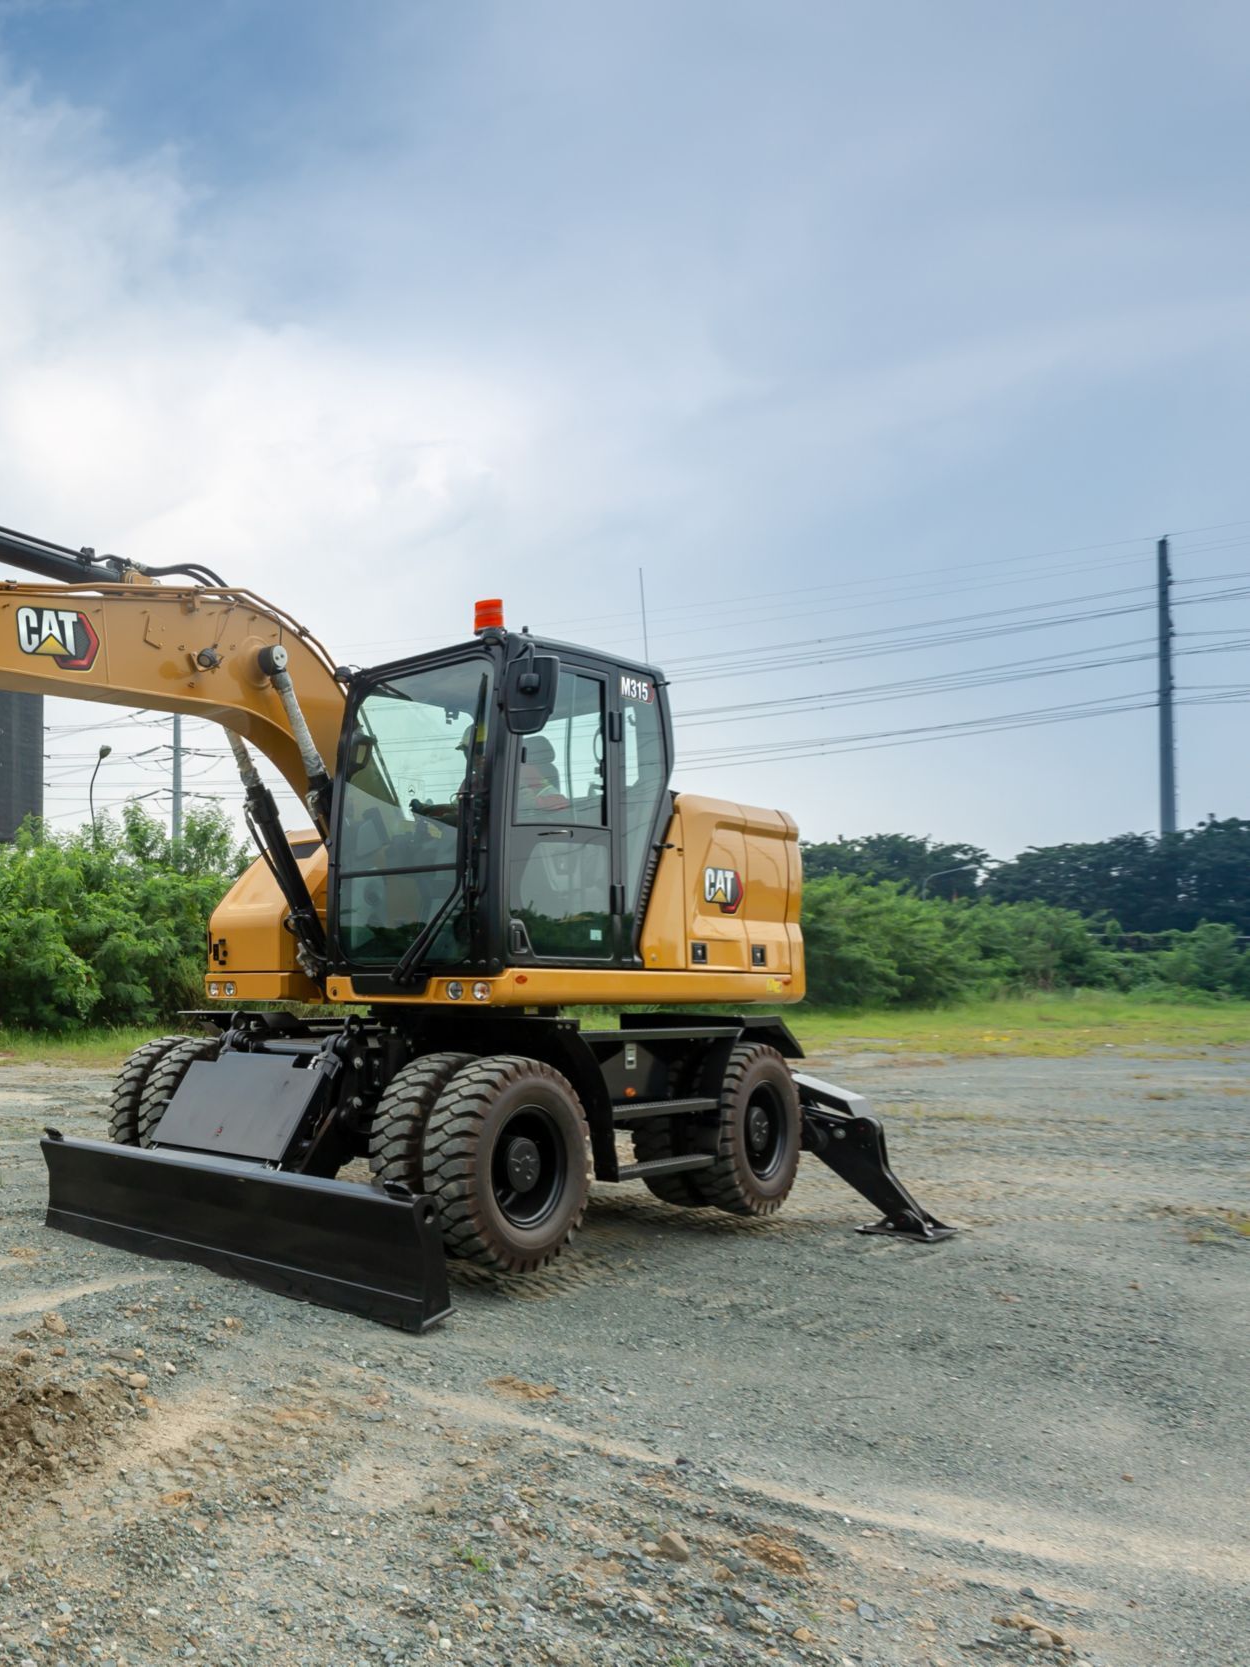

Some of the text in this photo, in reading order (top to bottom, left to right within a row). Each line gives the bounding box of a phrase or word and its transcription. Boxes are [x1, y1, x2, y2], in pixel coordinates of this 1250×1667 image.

[17, 607, 78, 656] CAT
[621, 676, 649, 701] M315
[705, 868, 734, 902] CAT
